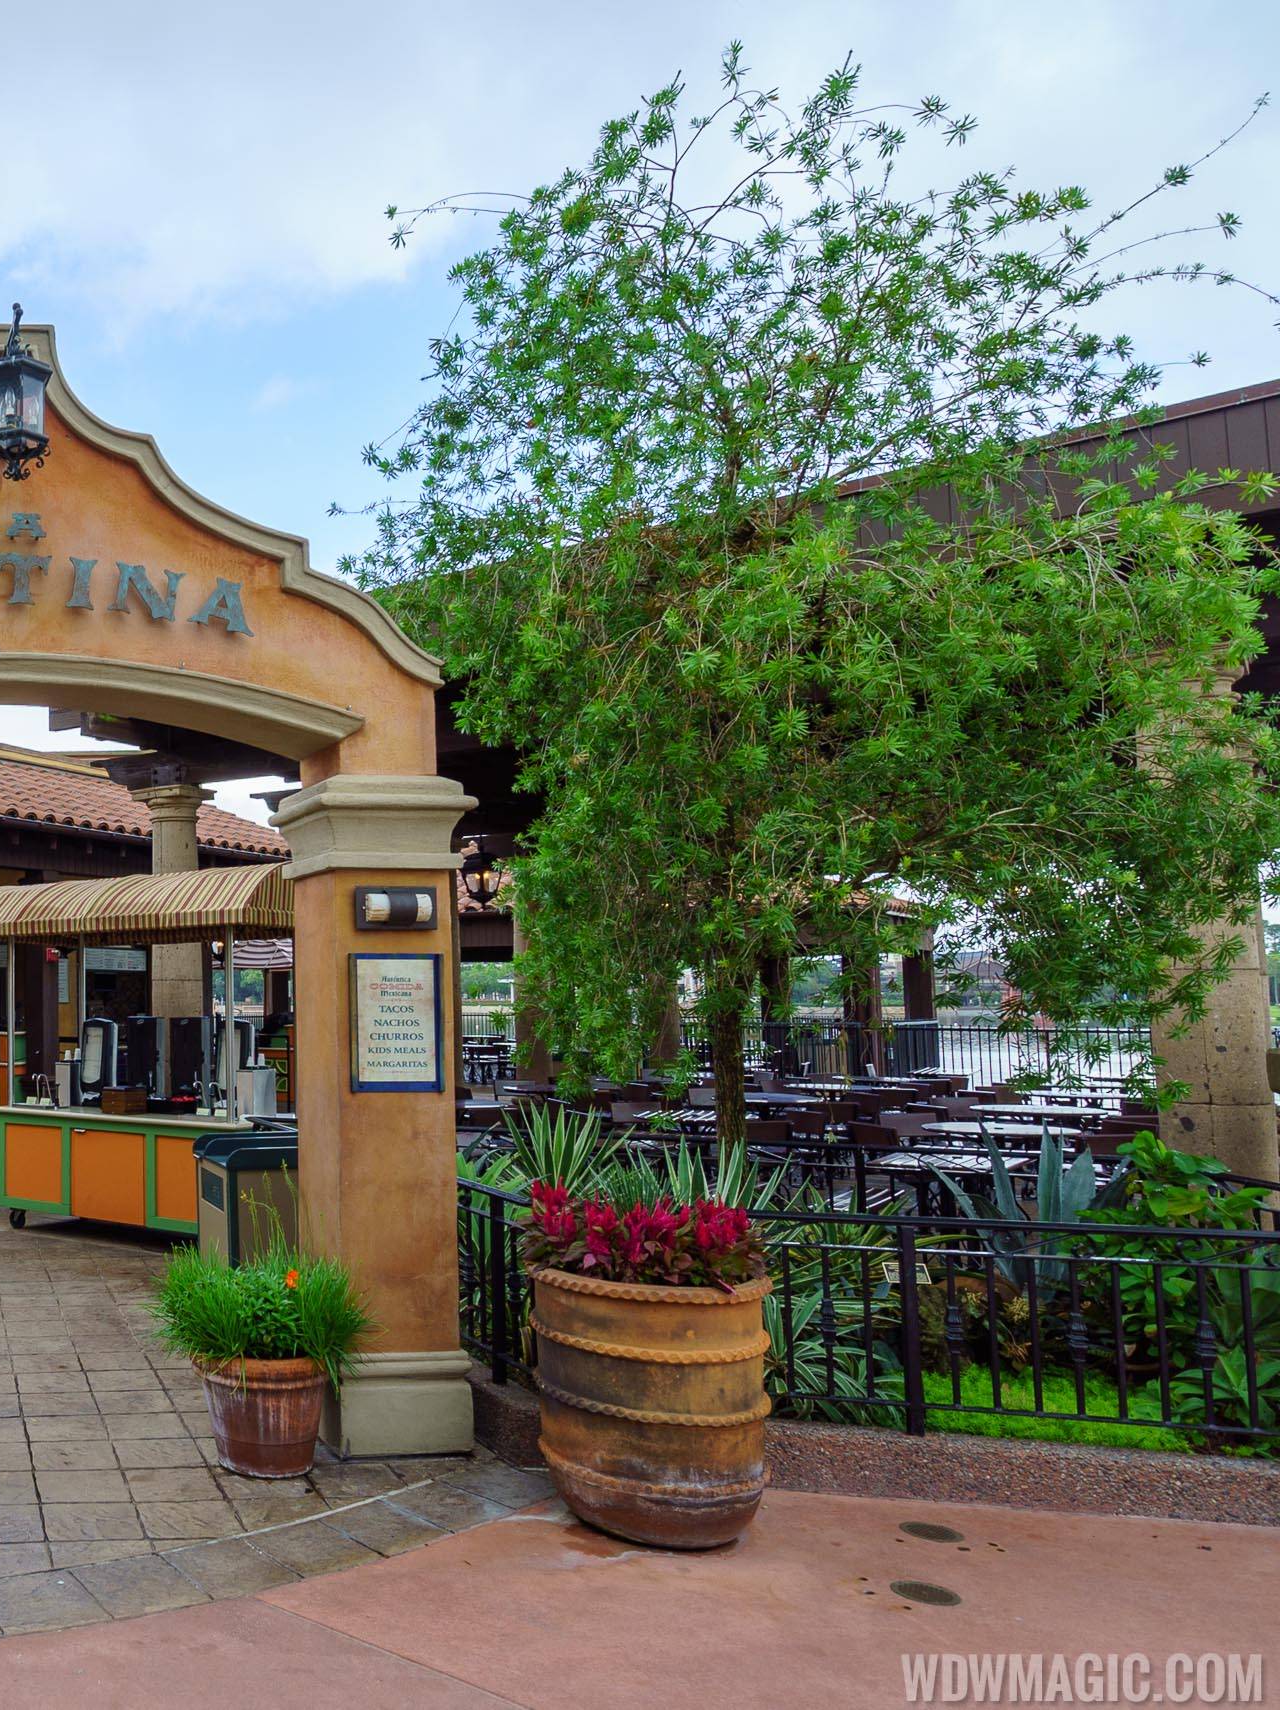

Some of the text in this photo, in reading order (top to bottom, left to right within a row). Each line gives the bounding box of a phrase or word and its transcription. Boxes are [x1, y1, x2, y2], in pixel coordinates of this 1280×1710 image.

[379, 1005, 414, 1013] TACOS
[374, 1019, 420, 1027] NACHOS
[370, 1032, 424, 1040] CHURROS
